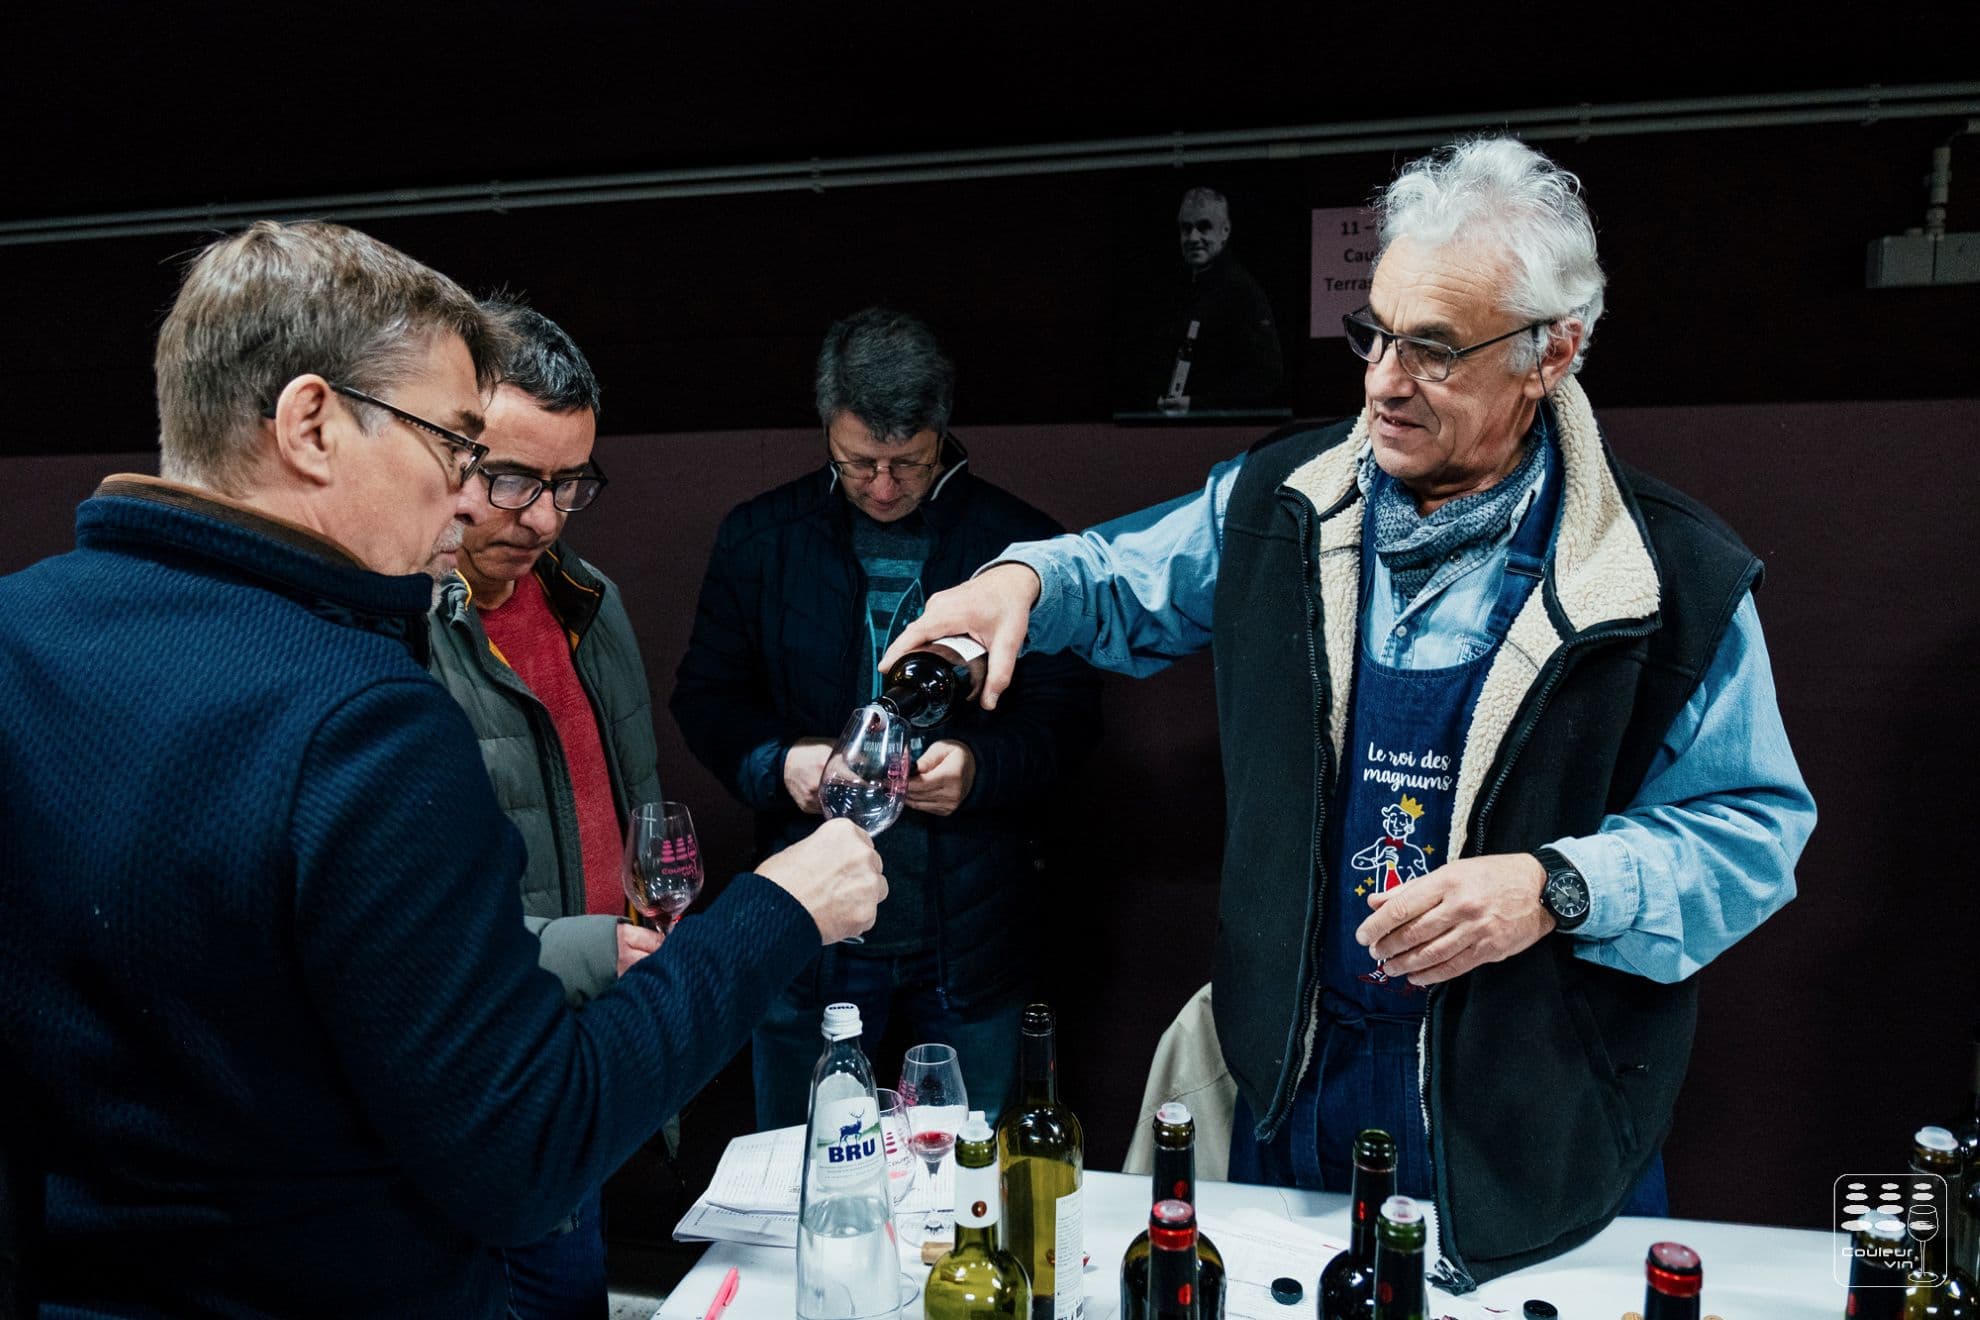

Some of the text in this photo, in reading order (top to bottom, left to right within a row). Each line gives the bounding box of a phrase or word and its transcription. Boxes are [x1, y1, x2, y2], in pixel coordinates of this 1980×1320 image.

[1341, 222, 1359, 235] 11
[1368, 742, 1451, 771] Le roi des
[1363, 767, 1453, 792] magnums
[828, 1138, 876, 1163] BRU
